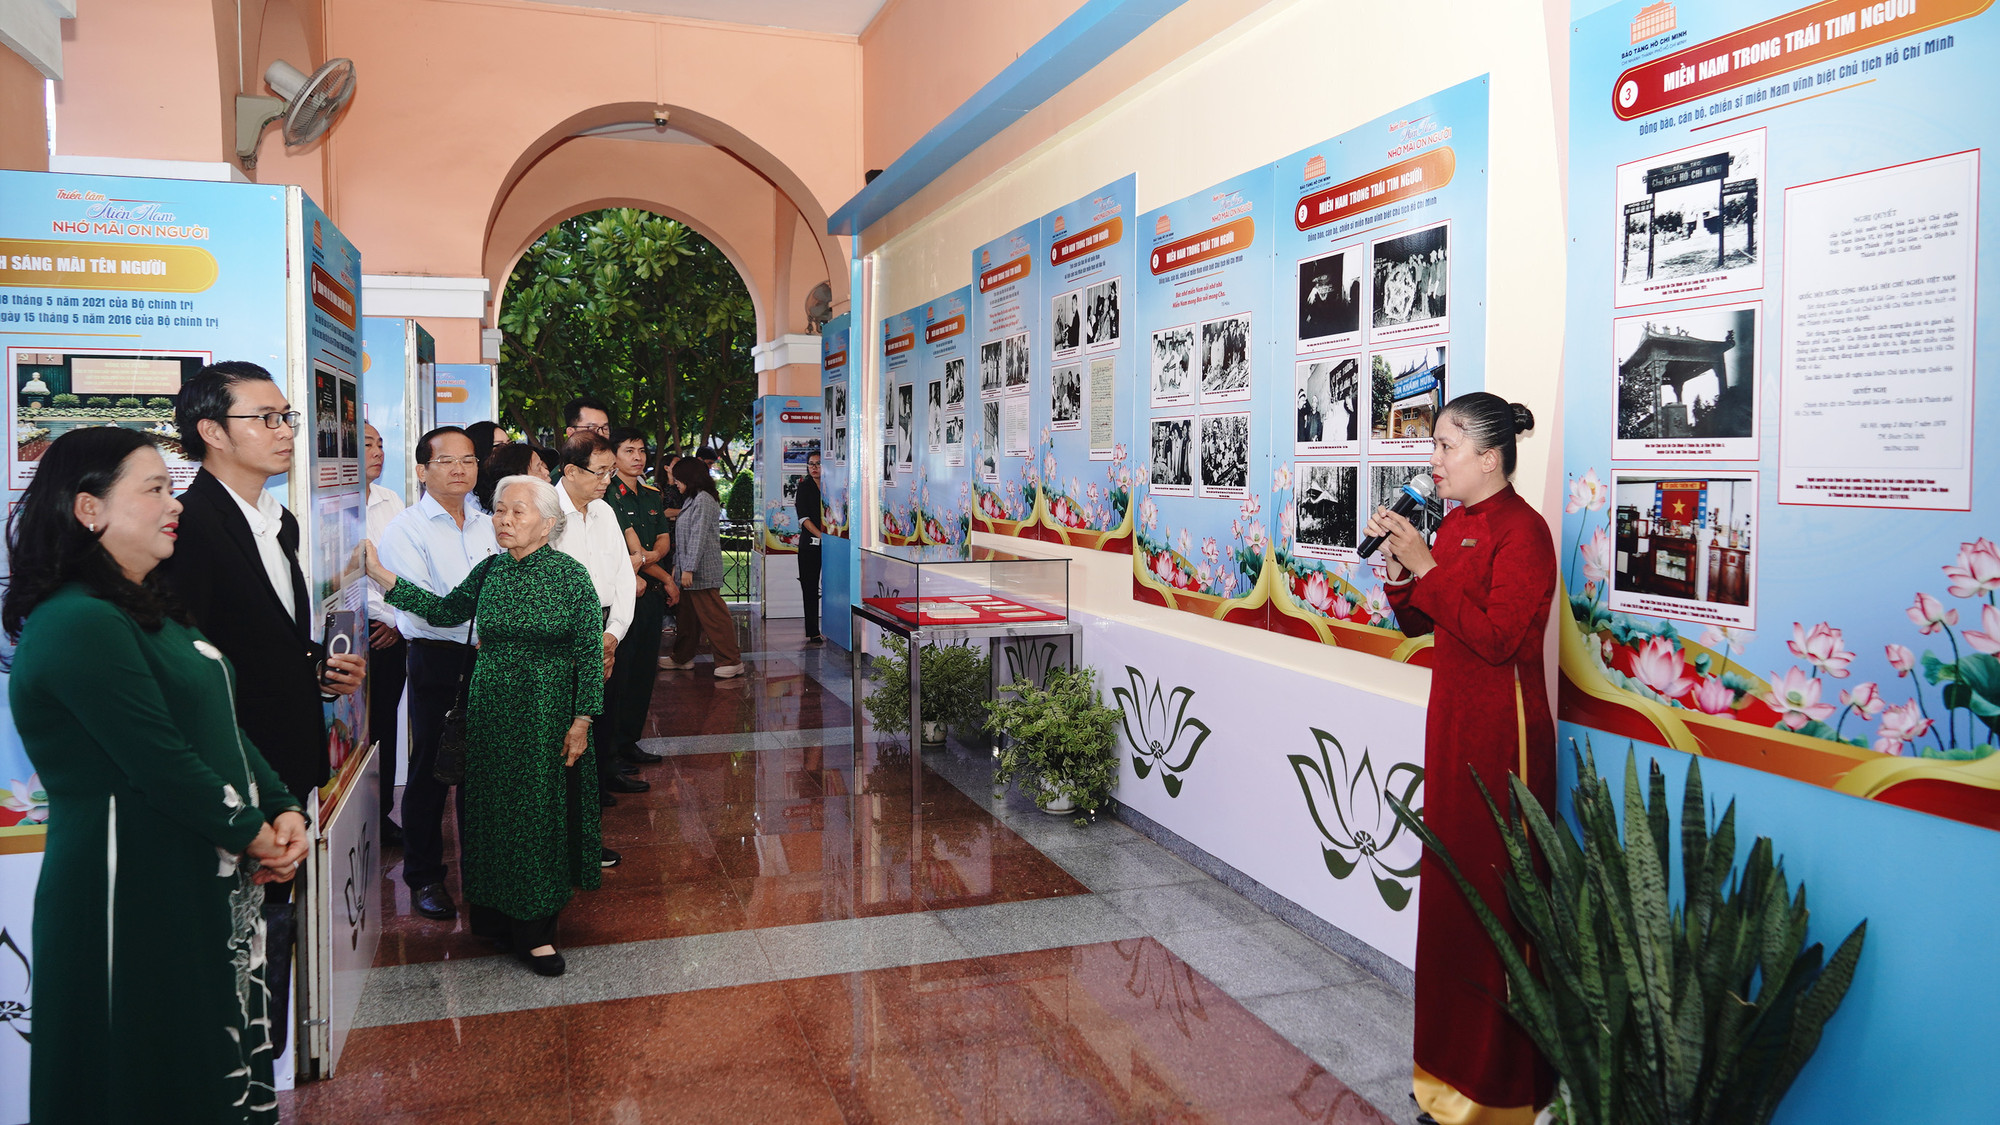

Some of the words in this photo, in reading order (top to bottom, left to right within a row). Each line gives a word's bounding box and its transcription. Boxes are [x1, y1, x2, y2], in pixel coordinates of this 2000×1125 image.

[1625, 87, 1632, 101] 3
[1663, 62, 1696, 92] MIỀN
[1699, 53, 1729, 81] NAM
[1732, 37, 1781, 70] TRONG
[1784, 21, 1821, 53] TRÁI
[1825, 11, 1856, 41] TIM
[57, 189, 82, 200] Triển
[84, 190, 105, 201] lãm
[86, 202, 131, 220] Miền
[130, 203, 175, 222] Nam
[52, 219, 90, 234] NHỚ
[94, 221, 124, 235] MÃI
[127, 223, 152, 236] ƠN
[155, 224, 209, 240] NGƯỜI
[11, 254, 53, 271] SÁNG
[57, 256, 86, 272] MÃI
[89, 257, 117, 274] TÊN
[121, 259, 167, 276] NGƯỜI
[12, 294, 43, 306] tháng
[46, 296, 53, 306] 5
[56, 295, 79, 307] năm
[82, 297, 105, 308] 2021
[109, 296, 128, 308] của
[131, 298, 144, 311] Bộ
[148, 299, 177, 310] chính
[180, 300, 193, 312] trị
[0, 310, 20, 323] gày
[24, 312, 35, 322] 15
[38, 312, 69, 324] tháng
[72, 313, 79, 323] 5
[82, 313, 105, 324] năm
[108, 314, 131, 325] 2016
[135, 313, 154, 325] của
[157, 315, 170, 328] Bộ
[174, 315, 202, 327] chính
[205, 317, 219, 329] trị
